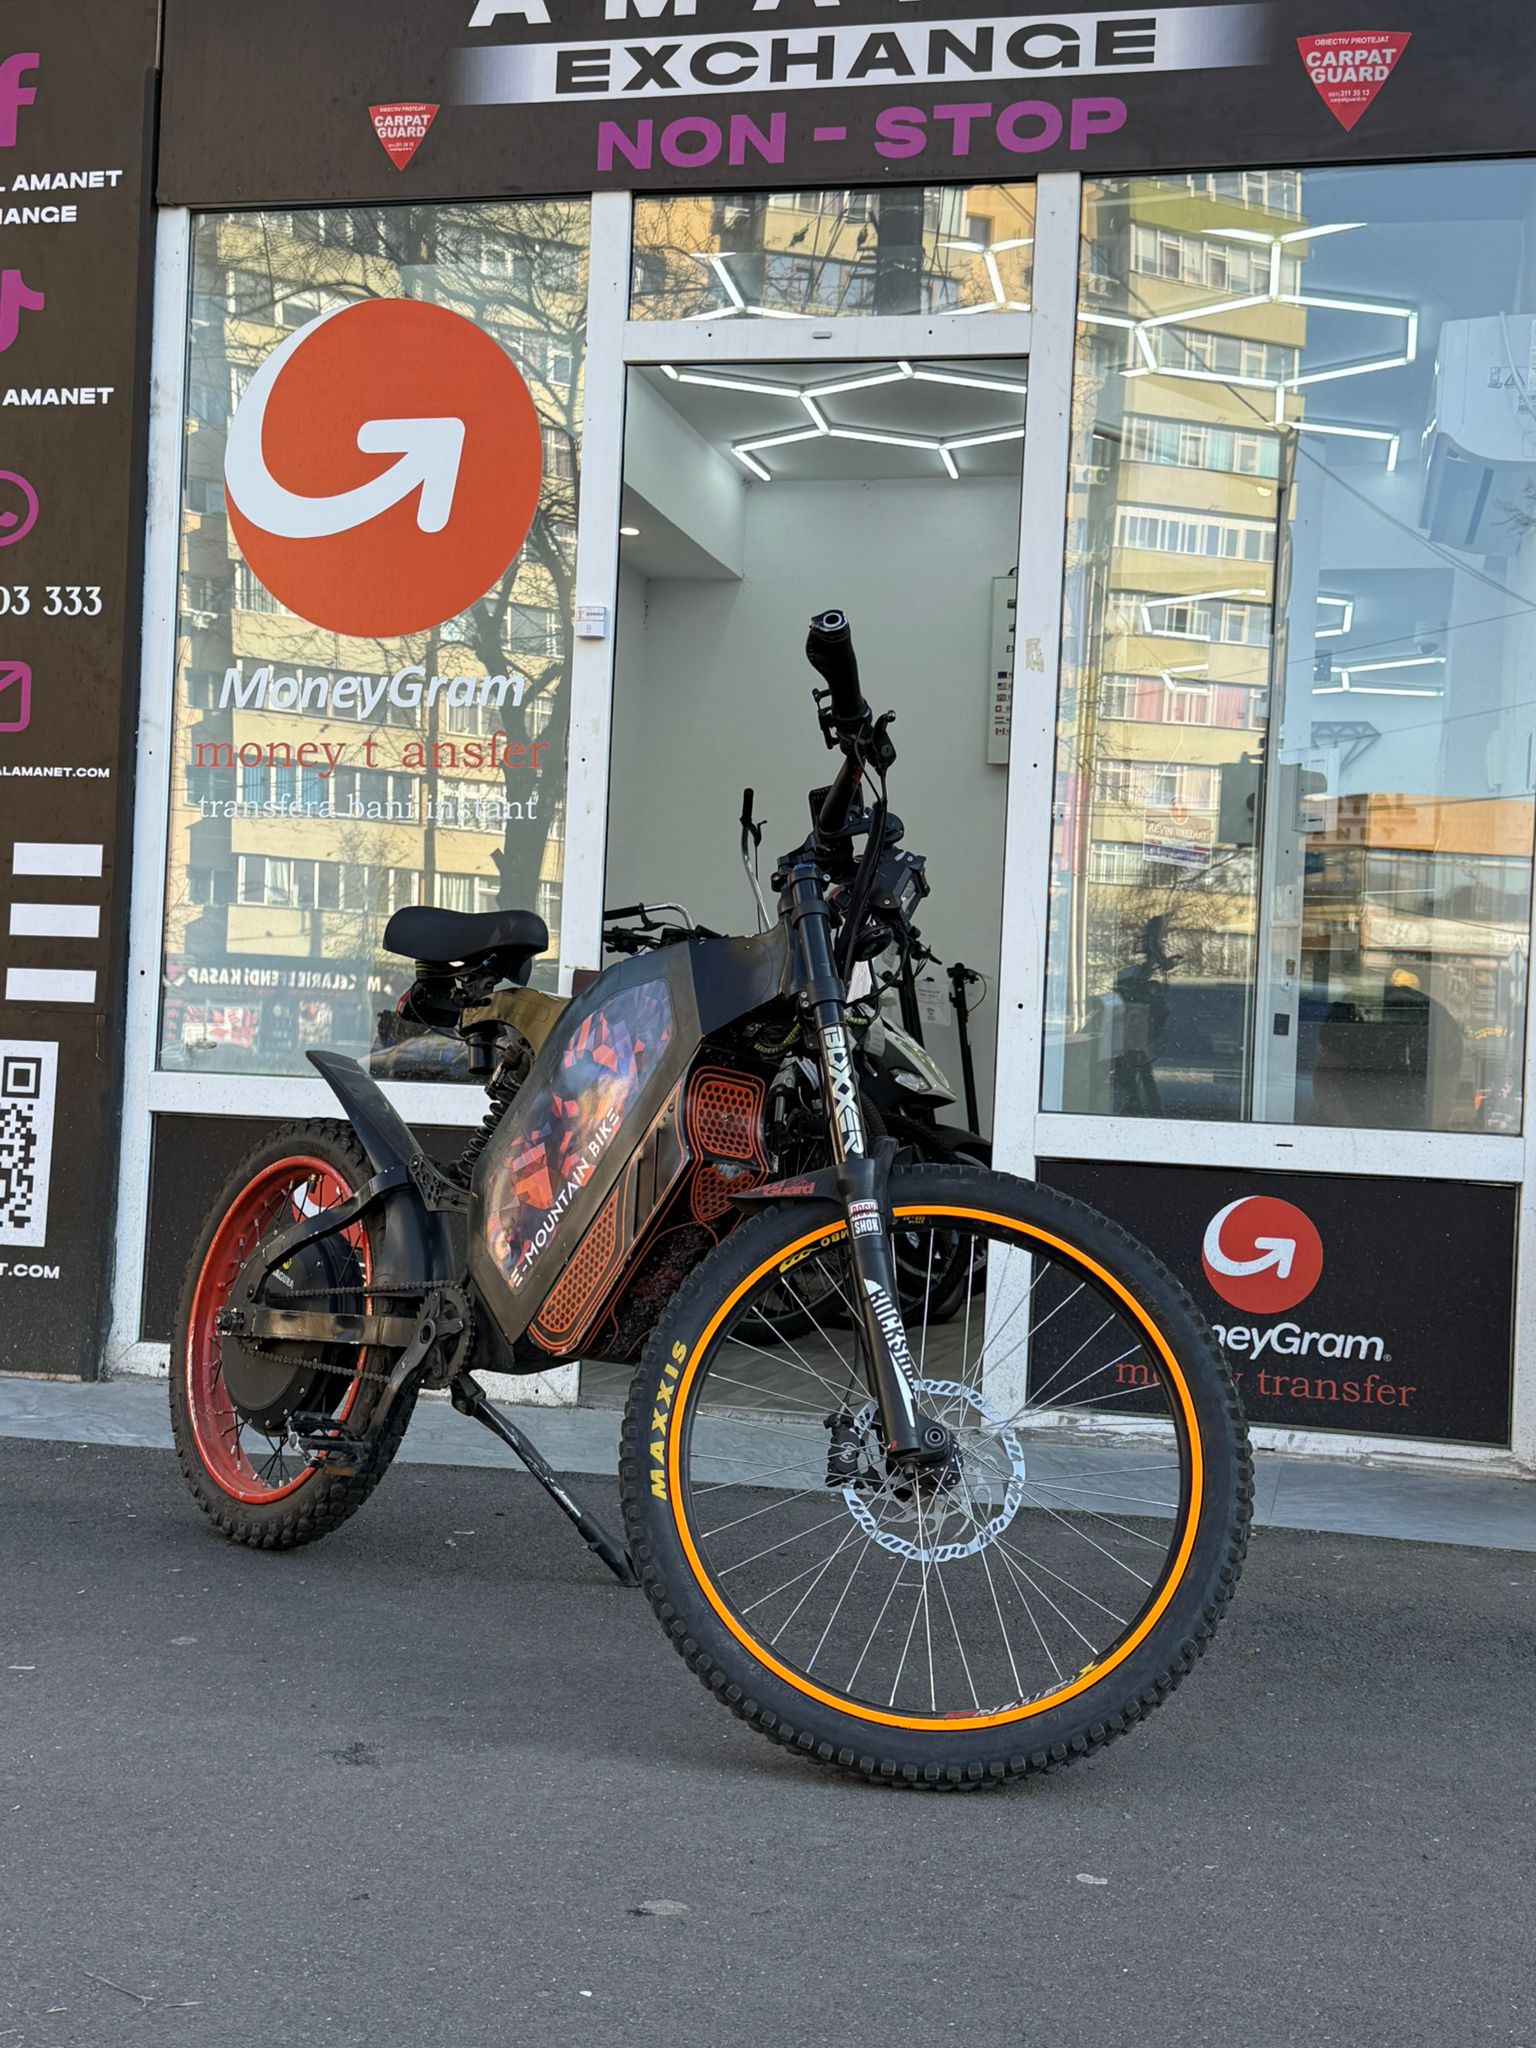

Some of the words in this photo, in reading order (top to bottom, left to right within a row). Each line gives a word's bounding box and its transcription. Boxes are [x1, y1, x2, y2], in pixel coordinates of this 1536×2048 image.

[555, 17, 1156, 94] EXCHANGE
[1306, 48, 1397, 67] CARPAT
[1310, 66, 1389, 84] GUARD
[374, 114, 431, 126] CARPAT
[377, 126, 426, 138] GUARD
[597, 112, 787, 171] NON
[874, 97, 1128, 158] STOP
[12, 170, 123, 191] AMANET
[0, 205, 77, 225] ANGE
[2, 387, 115, 406] AMANET
[43, 586, 103, 616] 333
[218, 664, 525, 720] MoneyGram
[0, 766, 110, 778] LAMANET.COM
[194, 740, 347, 779] money
[199, 795, 334, 820] transfera
[347, 794, 415, 821] bani
[426, 794, 538, 821] instant
[509, 1156, 591, 1288] E-MOUNTAIN
[587, 1106, 620, 1158] BIKE
[1258, 1368, 1417, 1407] transfer
[650, 1340, 687, 1500] MAXXIS
